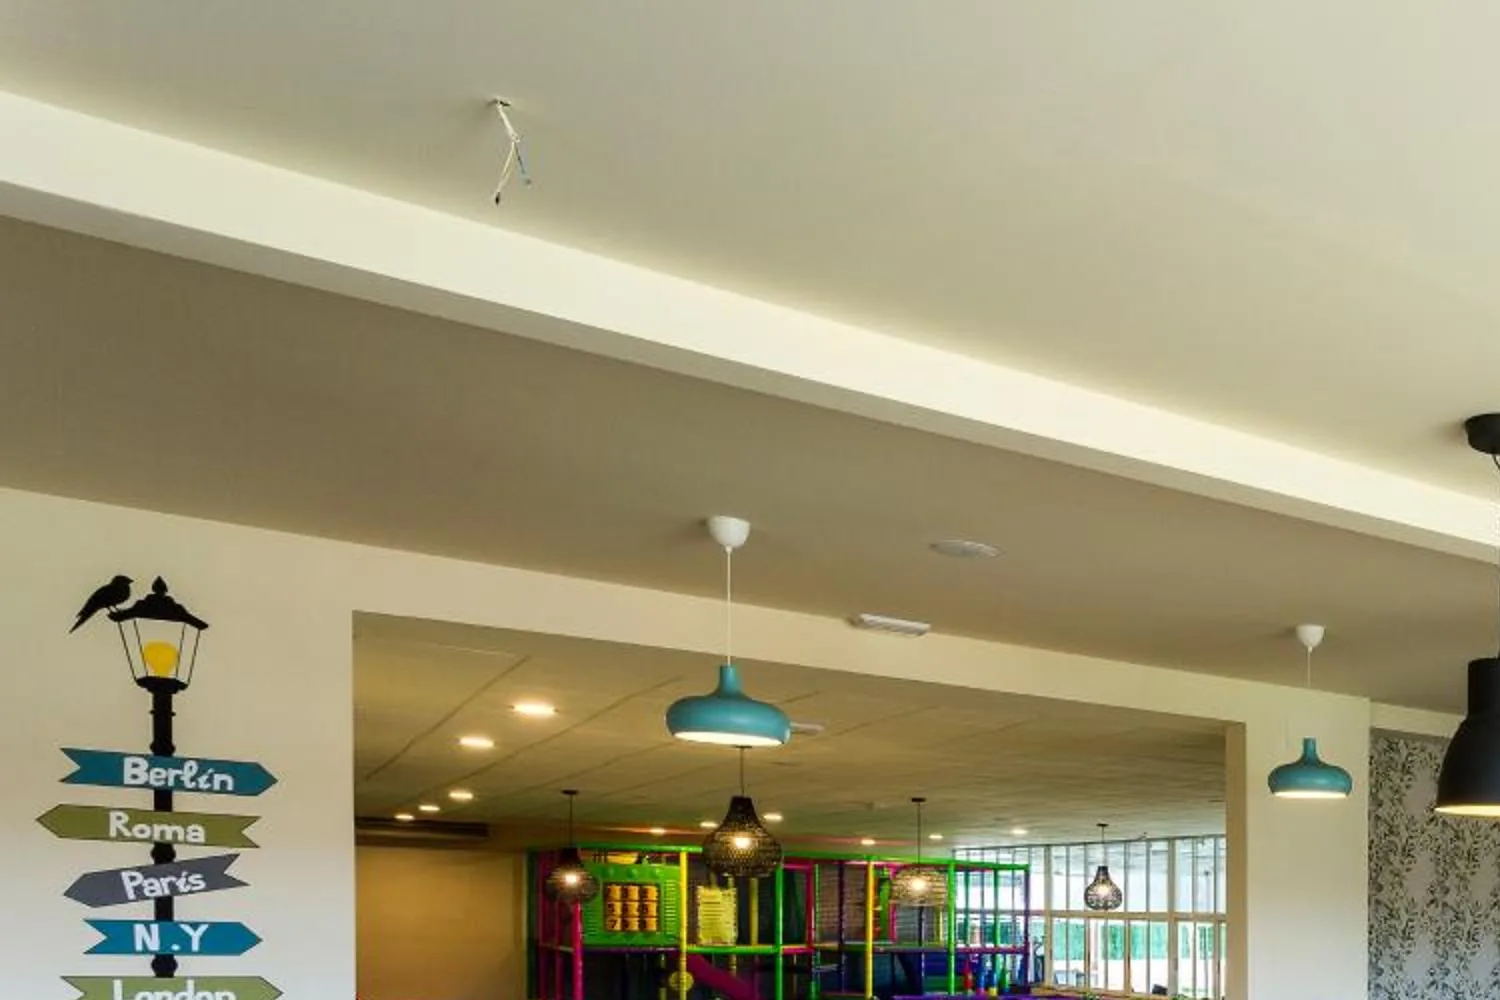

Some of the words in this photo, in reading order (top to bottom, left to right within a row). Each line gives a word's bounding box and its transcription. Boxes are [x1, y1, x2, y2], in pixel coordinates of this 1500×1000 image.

[122, 757, 233, 791] Berlin
[108, 811, 205, 843] Roma
[121, 871, 206, 900] Paris
